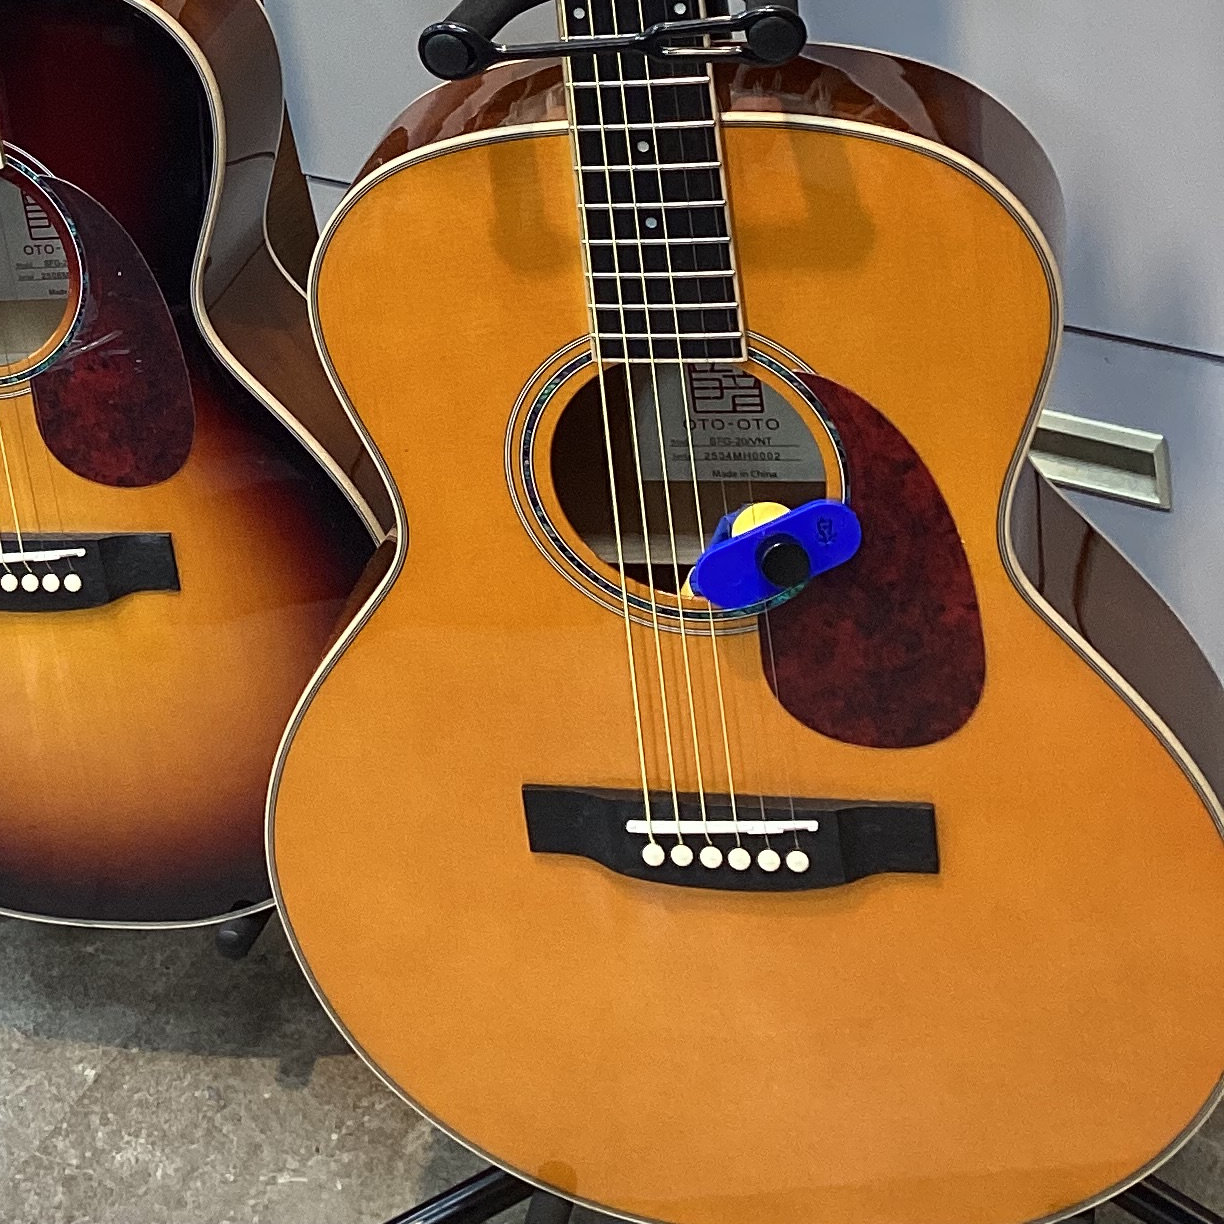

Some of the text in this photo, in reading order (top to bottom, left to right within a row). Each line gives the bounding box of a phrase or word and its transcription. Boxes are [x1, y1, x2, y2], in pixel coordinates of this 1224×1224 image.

[683, 417, 780, 432] OTO-OTO
[712, 469, 741, 478] Made
[751, 469, 778, 478] China
